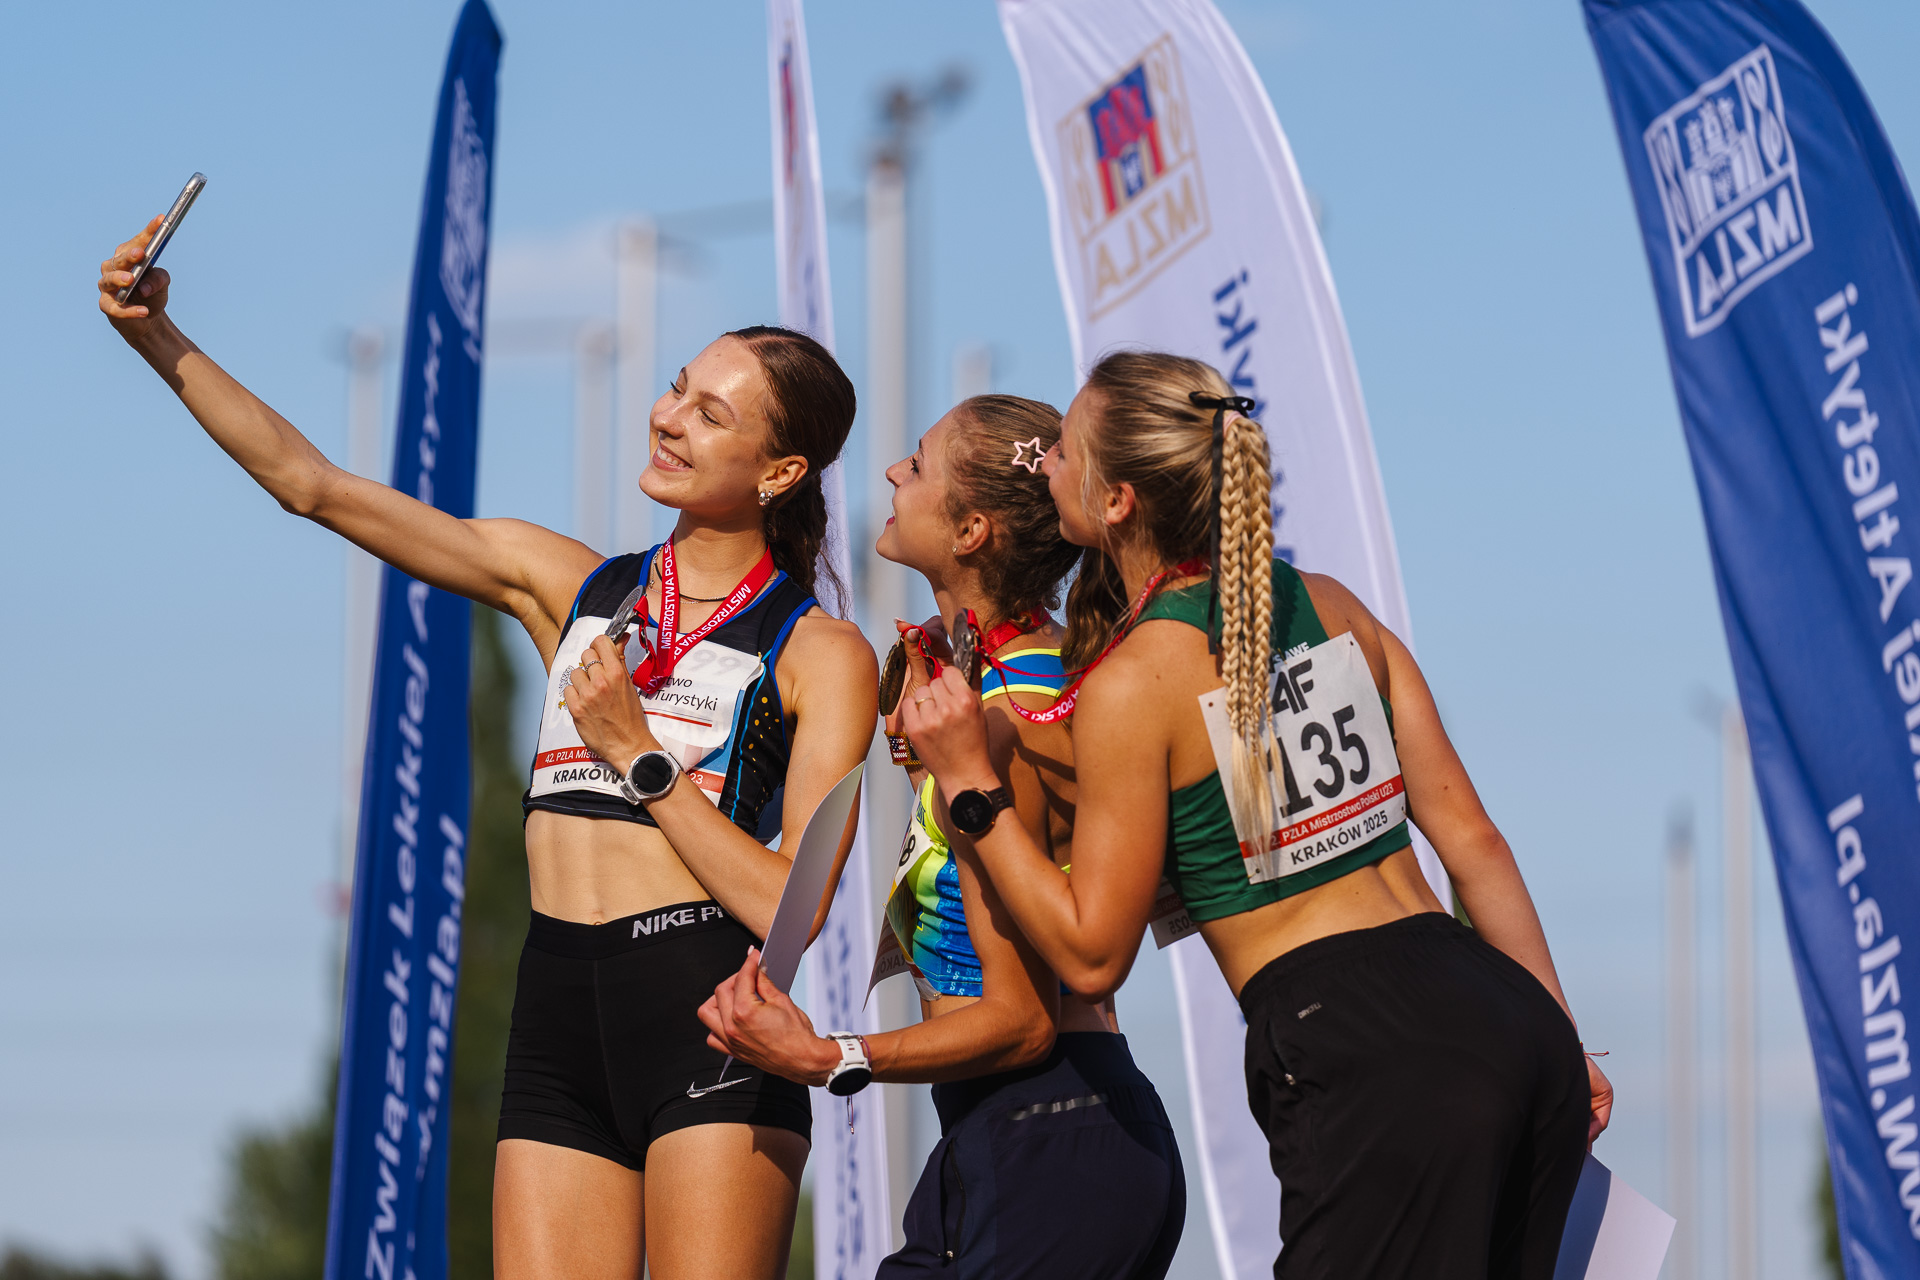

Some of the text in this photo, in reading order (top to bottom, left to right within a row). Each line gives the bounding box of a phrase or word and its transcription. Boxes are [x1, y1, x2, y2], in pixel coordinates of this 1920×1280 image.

[661, 577, 676, 650] MISTRZOSTWA
[682, 583, 752, 647] MISTRZOSTWA
[655, 690, 719, 712] Turystyki
[1031, 697, 1074, 722] POLSKI
[545, 754, 555, 764] 42.
[556, 751, 574, 762] PZLA
[552, 764, 622, 785] KRAKÓW
[1267, 704, 1371, 819] 135
[1282, 826, 1310, 842] PZLA
[1360, 789, 1381, 811] Polski
[1379, 783, 1395, 799] U23
[1291, 810, 1389, 866] KRAKÓW 2025
[632, 908, 696, 939] NIKE
